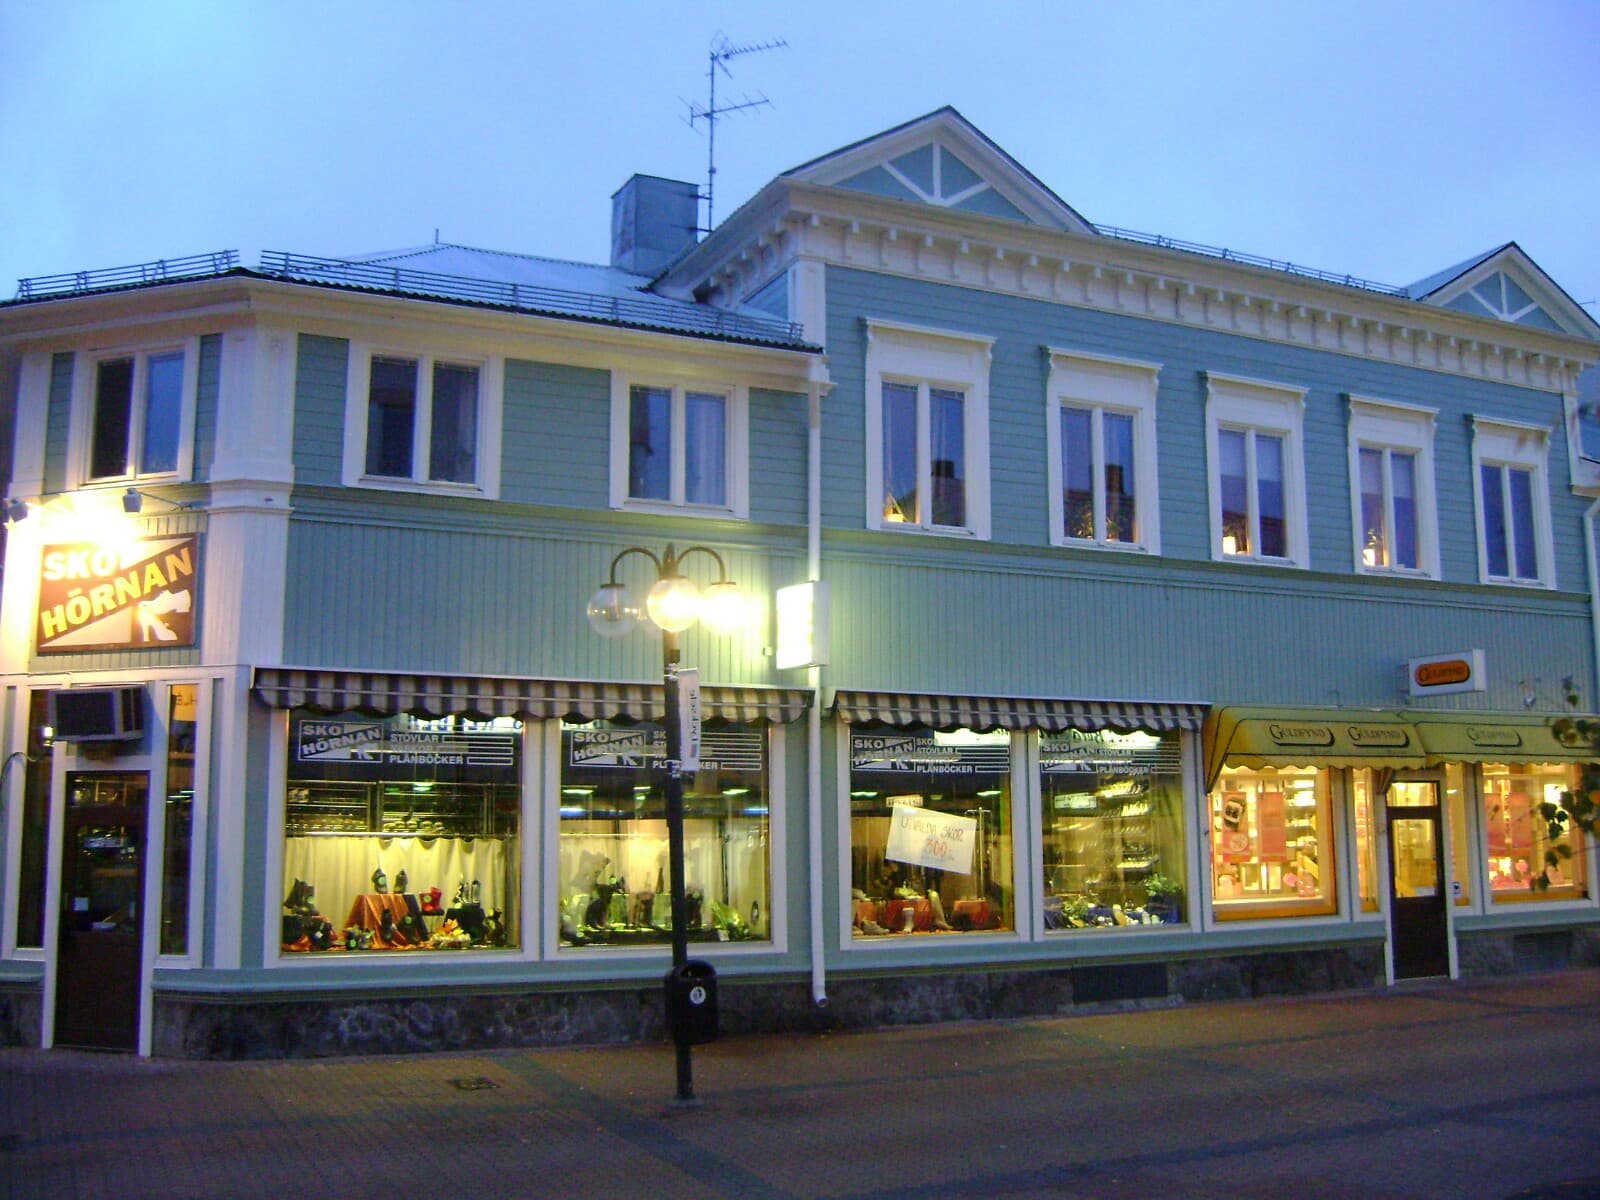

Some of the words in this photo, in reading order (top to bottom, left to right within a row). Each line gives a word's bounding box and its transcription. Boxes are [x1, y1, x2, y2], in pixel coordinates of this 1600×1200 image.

[41, 548, 193, 638] HÖRNAN
[303, 725, 341, 736] SKO
[1269, 724, 1325, 739] GULDFYND
[302, 728, 381, 755] HÖRNAN
[574, 732, 609, 742] SKO
[854, 739, 883, 749] SKO
[1043, 743, 1070, 752] SKO
[390, 753, 464, 764] PLÅNBÖCKER
